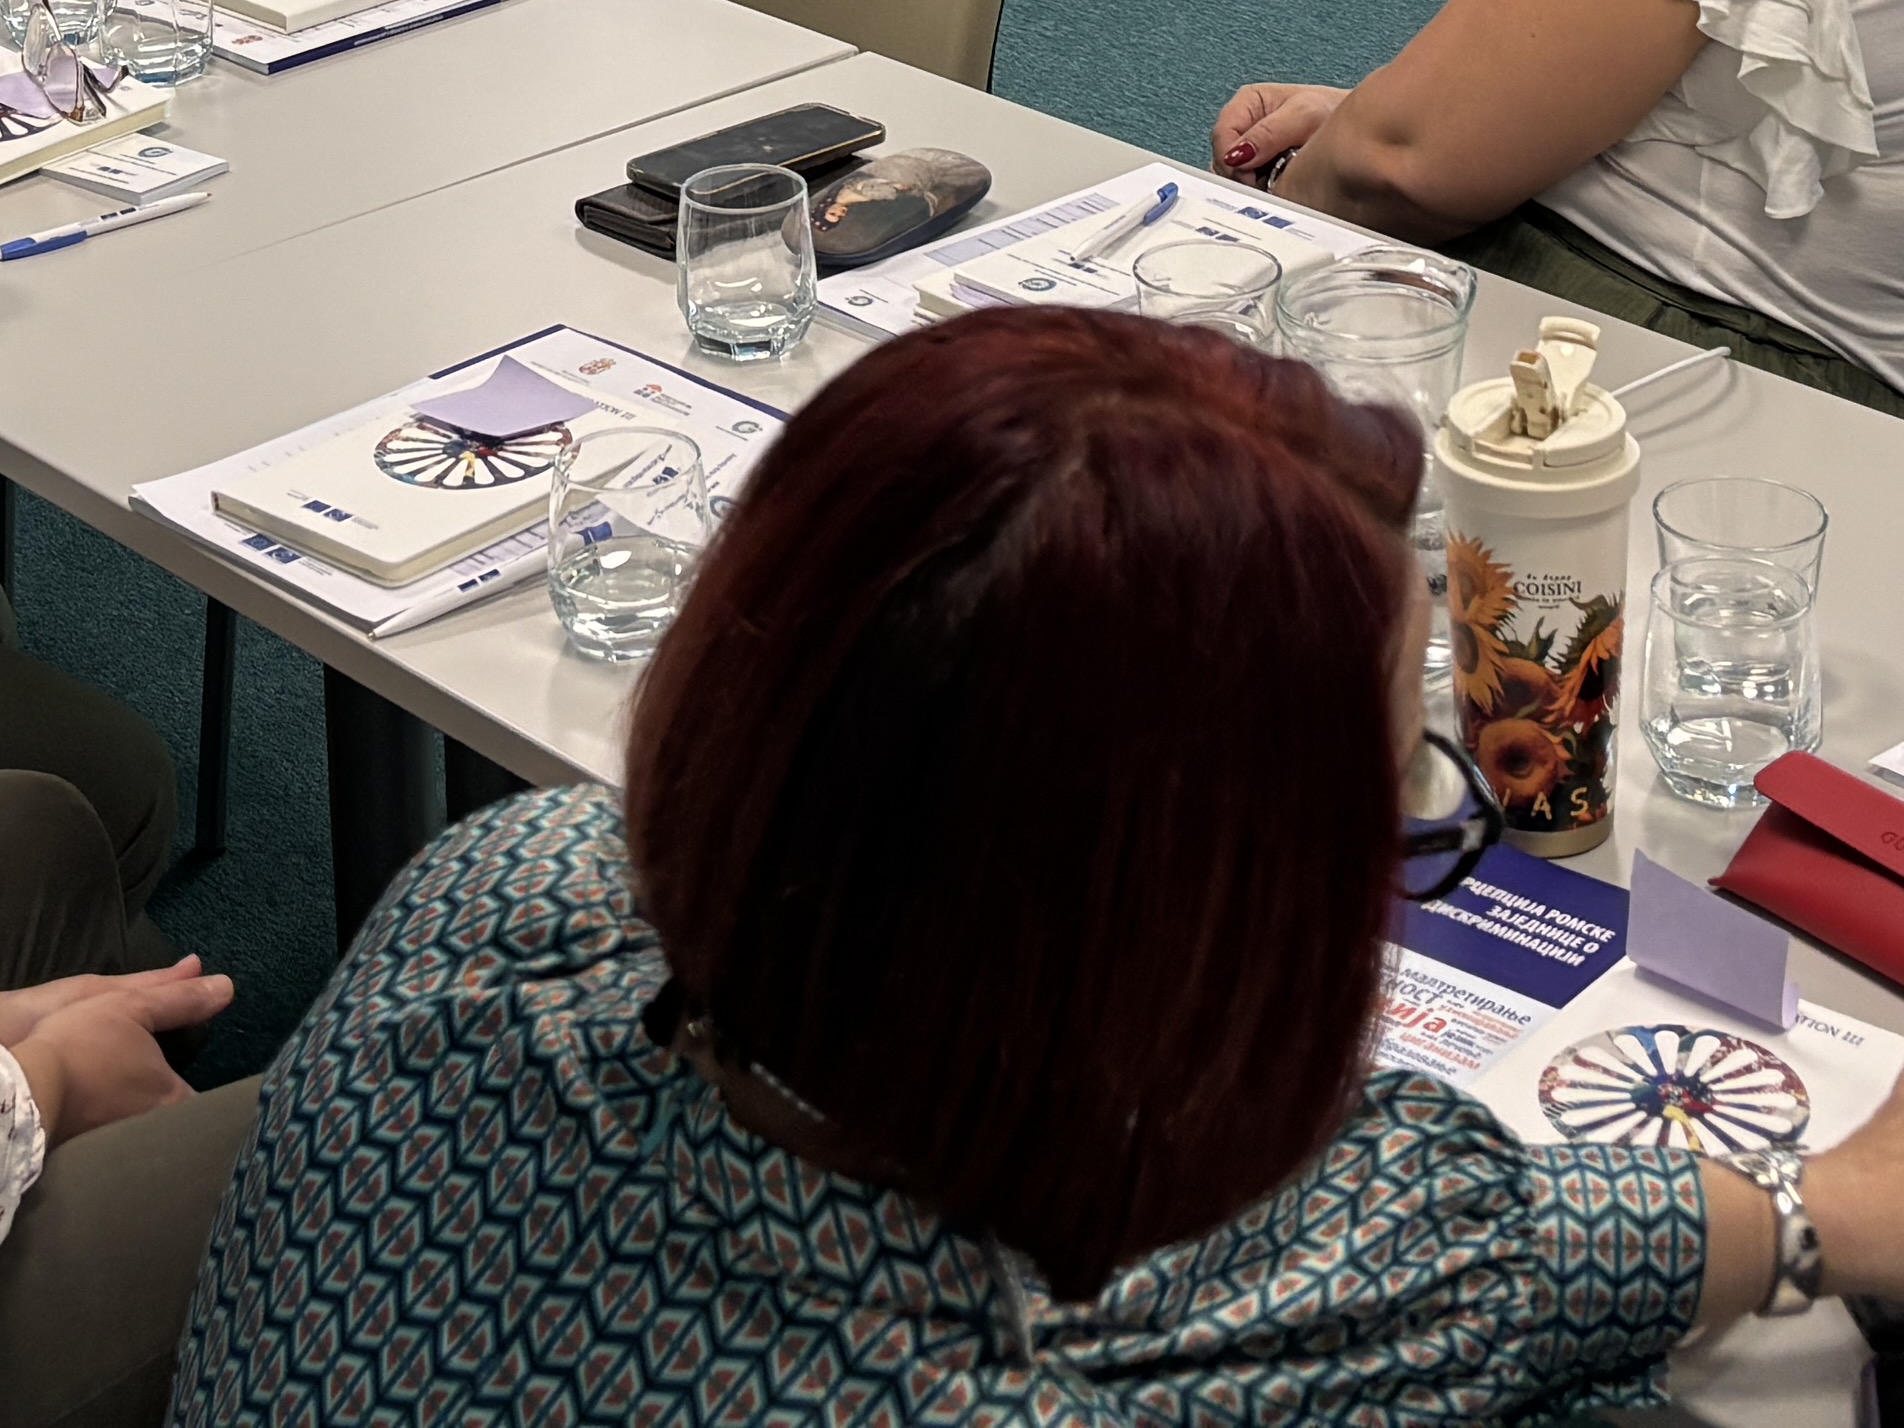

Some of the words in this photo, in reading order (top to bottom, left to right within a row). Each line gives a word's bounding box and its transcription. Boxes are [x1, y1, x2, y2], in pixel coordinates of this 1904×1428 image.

[1420, 899, 1586, 967] ДИСКРИМИНАЦИЈИ
[1461, 877, 1546, 917] РЦЕПЦИЈА
[1545, 909, 1616, 943] РОМСКЕ
[1486, 905, 1586, 948] ЗАЈЕДНИЦЕ
[1586, 942, 1600, 954] О
[1386, 1002, 1447, 1033] ија
[1401, 968, 1531, 1026] малтретирање
